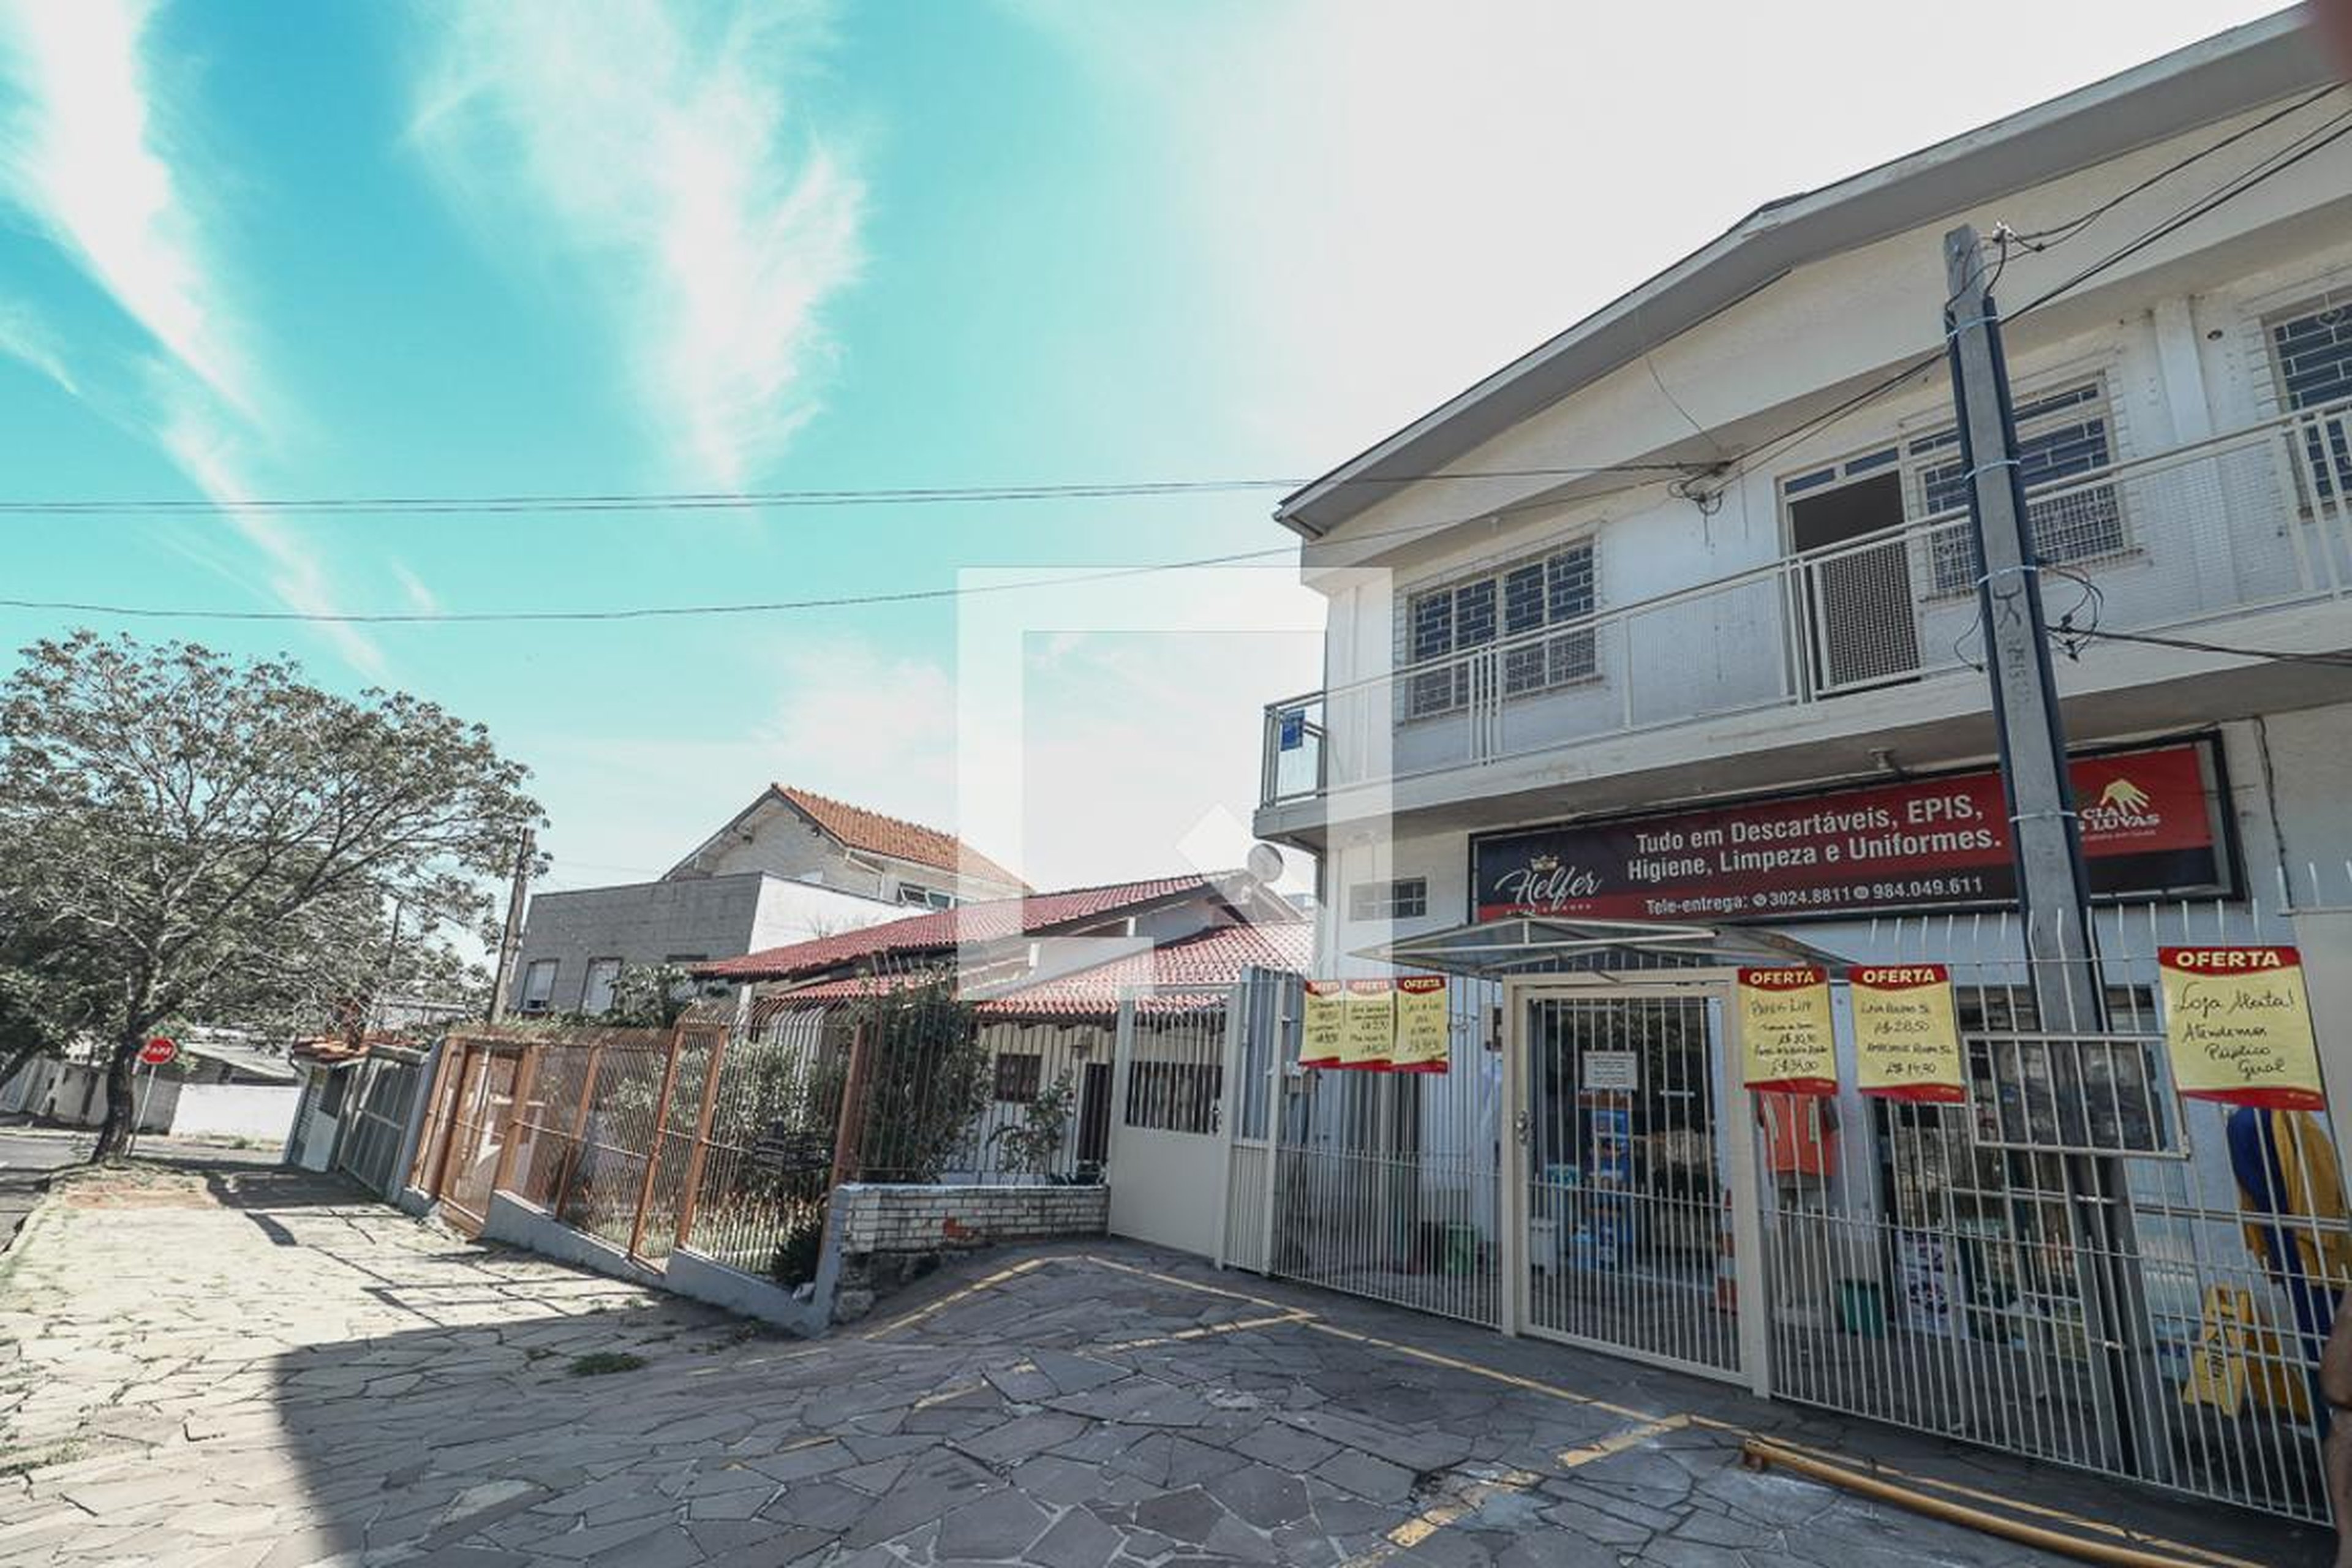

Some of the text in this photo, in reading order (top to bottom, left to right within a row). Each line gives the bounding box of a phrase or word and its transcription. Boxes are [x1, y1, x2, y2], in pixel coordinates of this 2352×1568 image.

[1636, 794, 1983, 853] Tudo em Descartáveis, EPIS,
[2092, 814, 2160, 831] LUVAS
[1627, 828, 2002, 883] Higiene, Limpeza e Uniformes.
[1494, 866, 1603, 911] Helfer
[1646, 876, 1983, 915] Tele-entrega: 3024.8811 984.049.611
[1749, 970, 1815, 984] OFERTA
[1863, 968, 1936, 983] OFERTA
[2176, 951, 2281, 967] OFERTA
[2174, 981, 2222, 1018] Loja
